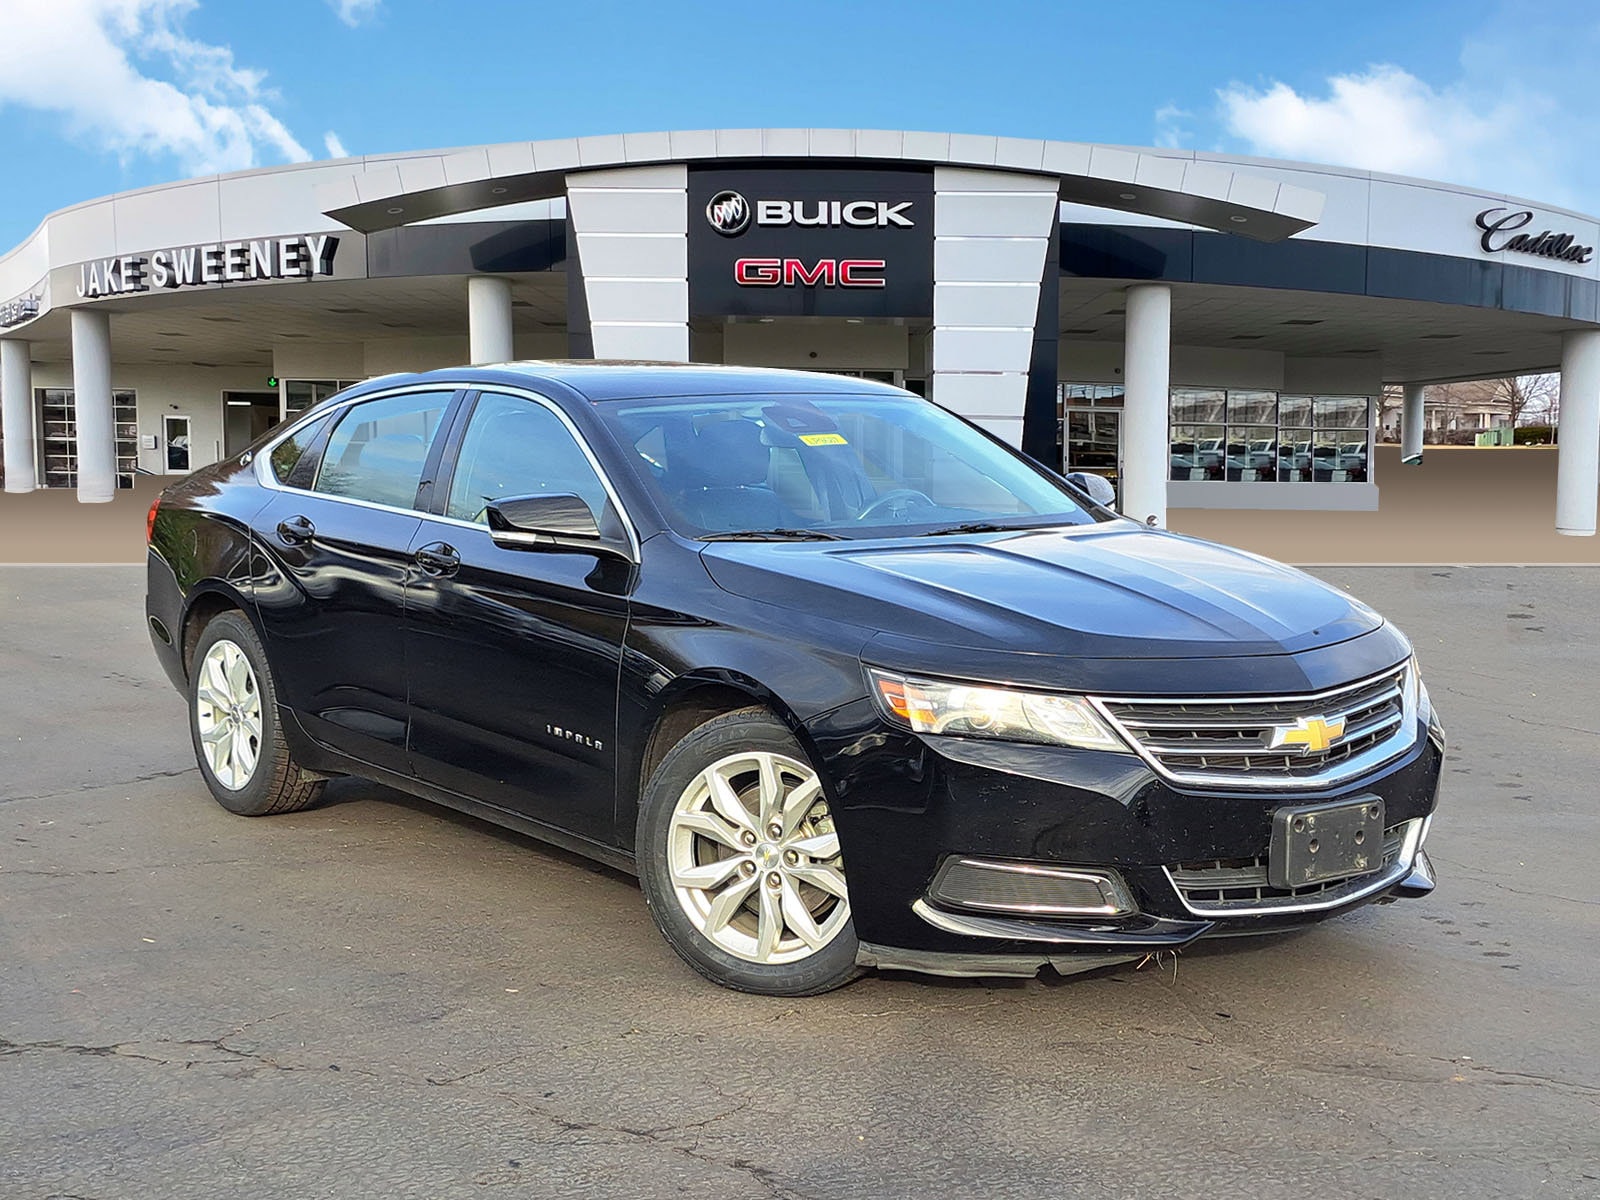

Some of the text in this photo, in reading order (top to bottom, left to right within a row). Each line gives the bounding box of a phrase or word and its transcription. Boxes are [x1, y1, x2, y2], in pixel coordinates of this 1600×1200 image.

[757, 201, 915, 226] BUICK
[1475, 207, 1593, 263] Cadillac
[76, 235, 332, 298] JAKE SWEENEY
[735, 258, 885, 287] GMC
[546, 724, 603, 751] IMPALA
